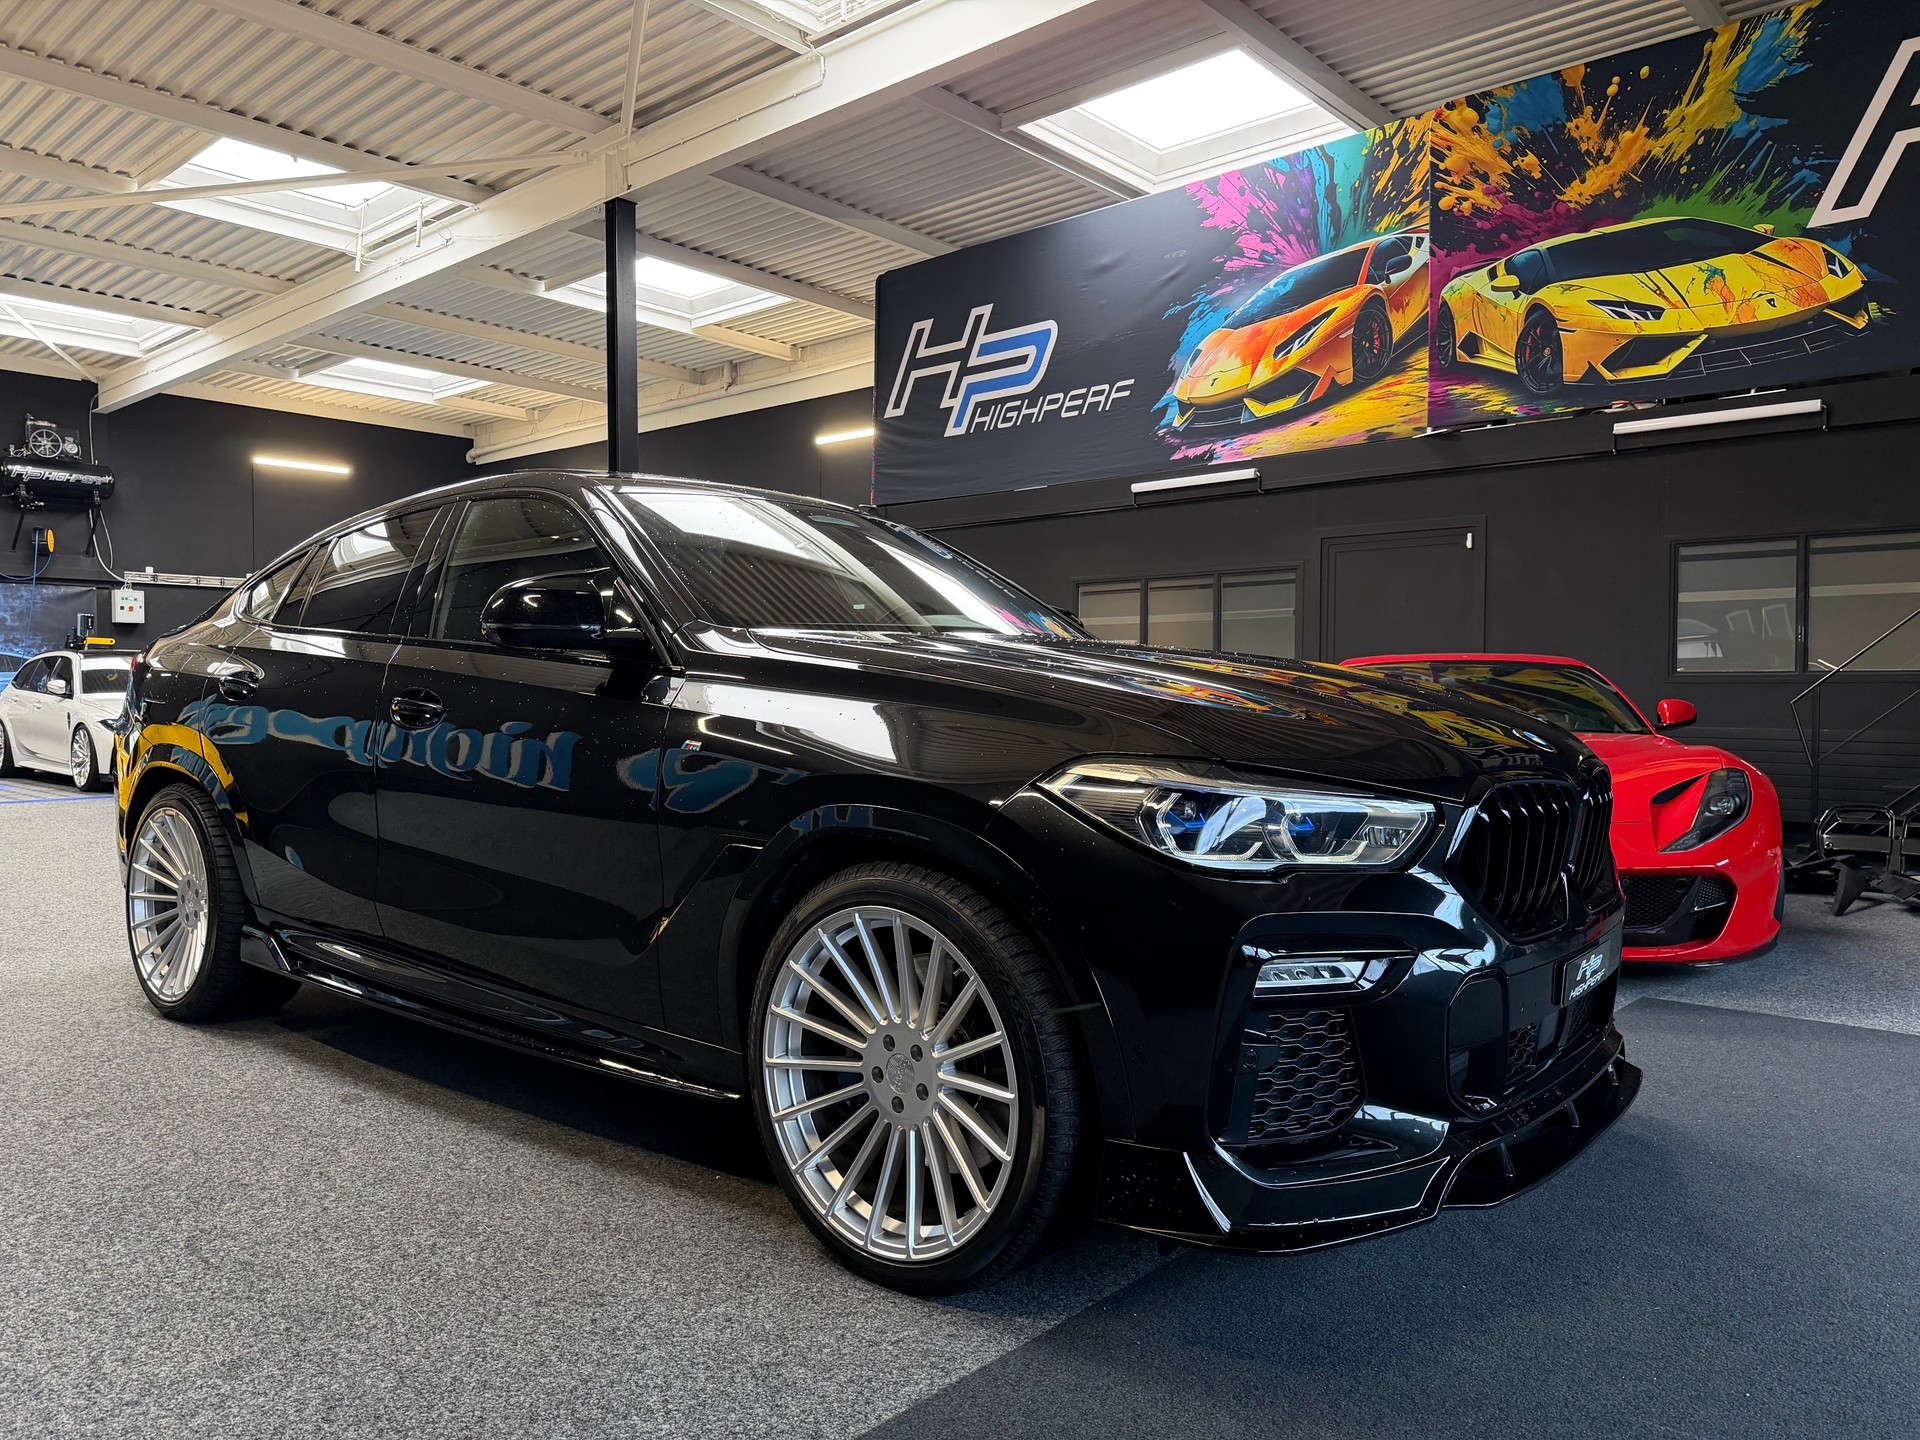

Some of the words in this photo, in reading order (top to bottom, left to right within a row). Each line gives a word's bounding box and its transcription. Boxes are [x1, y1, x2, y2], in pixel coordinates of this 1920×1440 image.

[883, 303, 1059, 438] HP
[970, 378, 1135, 434] HIGHPERF
[1568, 968, 1606, 1001] HIGHPERF
